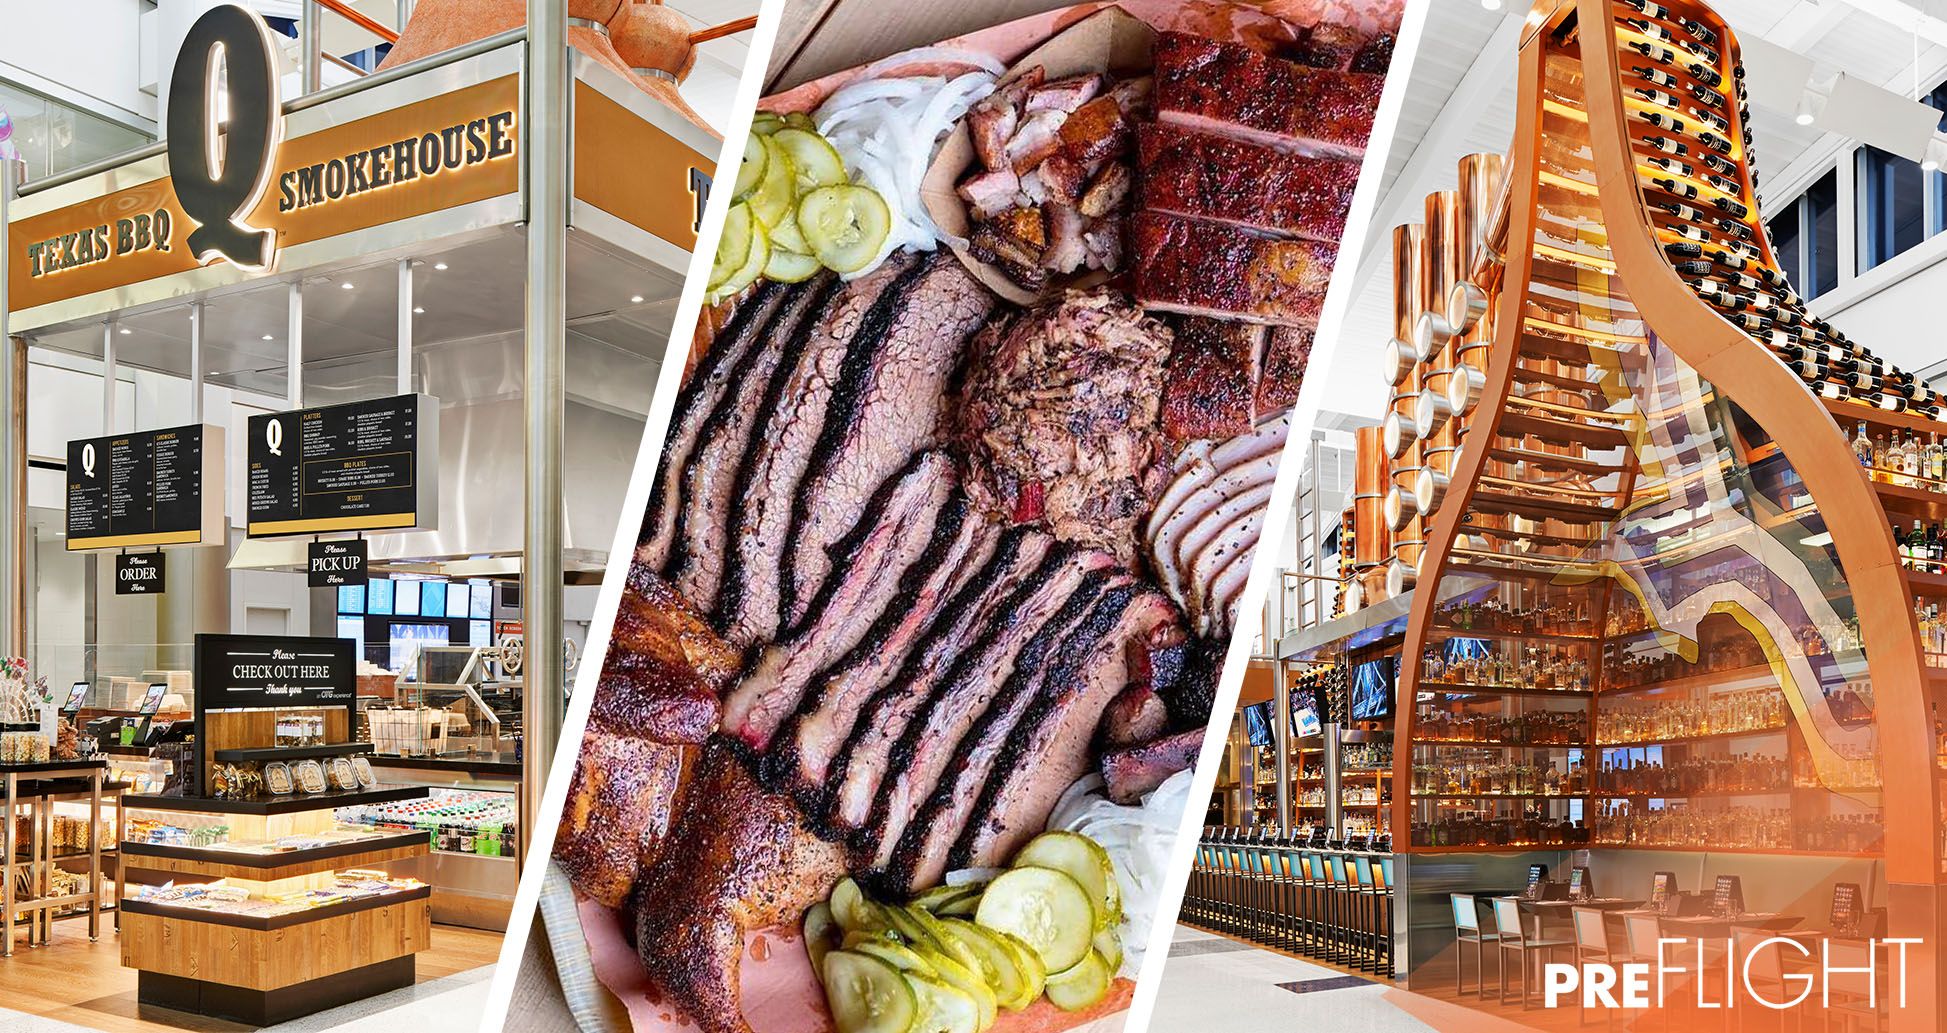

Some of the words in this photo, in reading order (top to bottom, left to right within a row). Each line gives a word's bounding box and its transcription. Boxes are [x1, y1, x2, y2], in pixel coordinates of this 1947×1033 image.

[28, 223, 109, 278] TEXAS
[116, 207, 173, 257] BBQ
[166, 4, 283, 273] Q
[279, 110, 515, 213] SMOKEHOUSE
[266, 418, 282, 456] Q
[81, 443, 96, 478] Q
[325, 544, 347, 554] Please
[129, 557, 148, 565] Please
[311, 558, 341, 572] PICK
[342, 555, 361, 571] UP
[120, 567, 157, 580] ORDER
[327, 573, 344, 584] Here
[131, 584, 145, 592] Here
[272, 648, 296, 660] Please
[232, 664, 272, 679] CHECK
[274, 664, 298, 679] OUT
[300, 664, 330, 678] HERE
[265, 683, 287, 695] Thank
[289, 686, 302, 697] you
